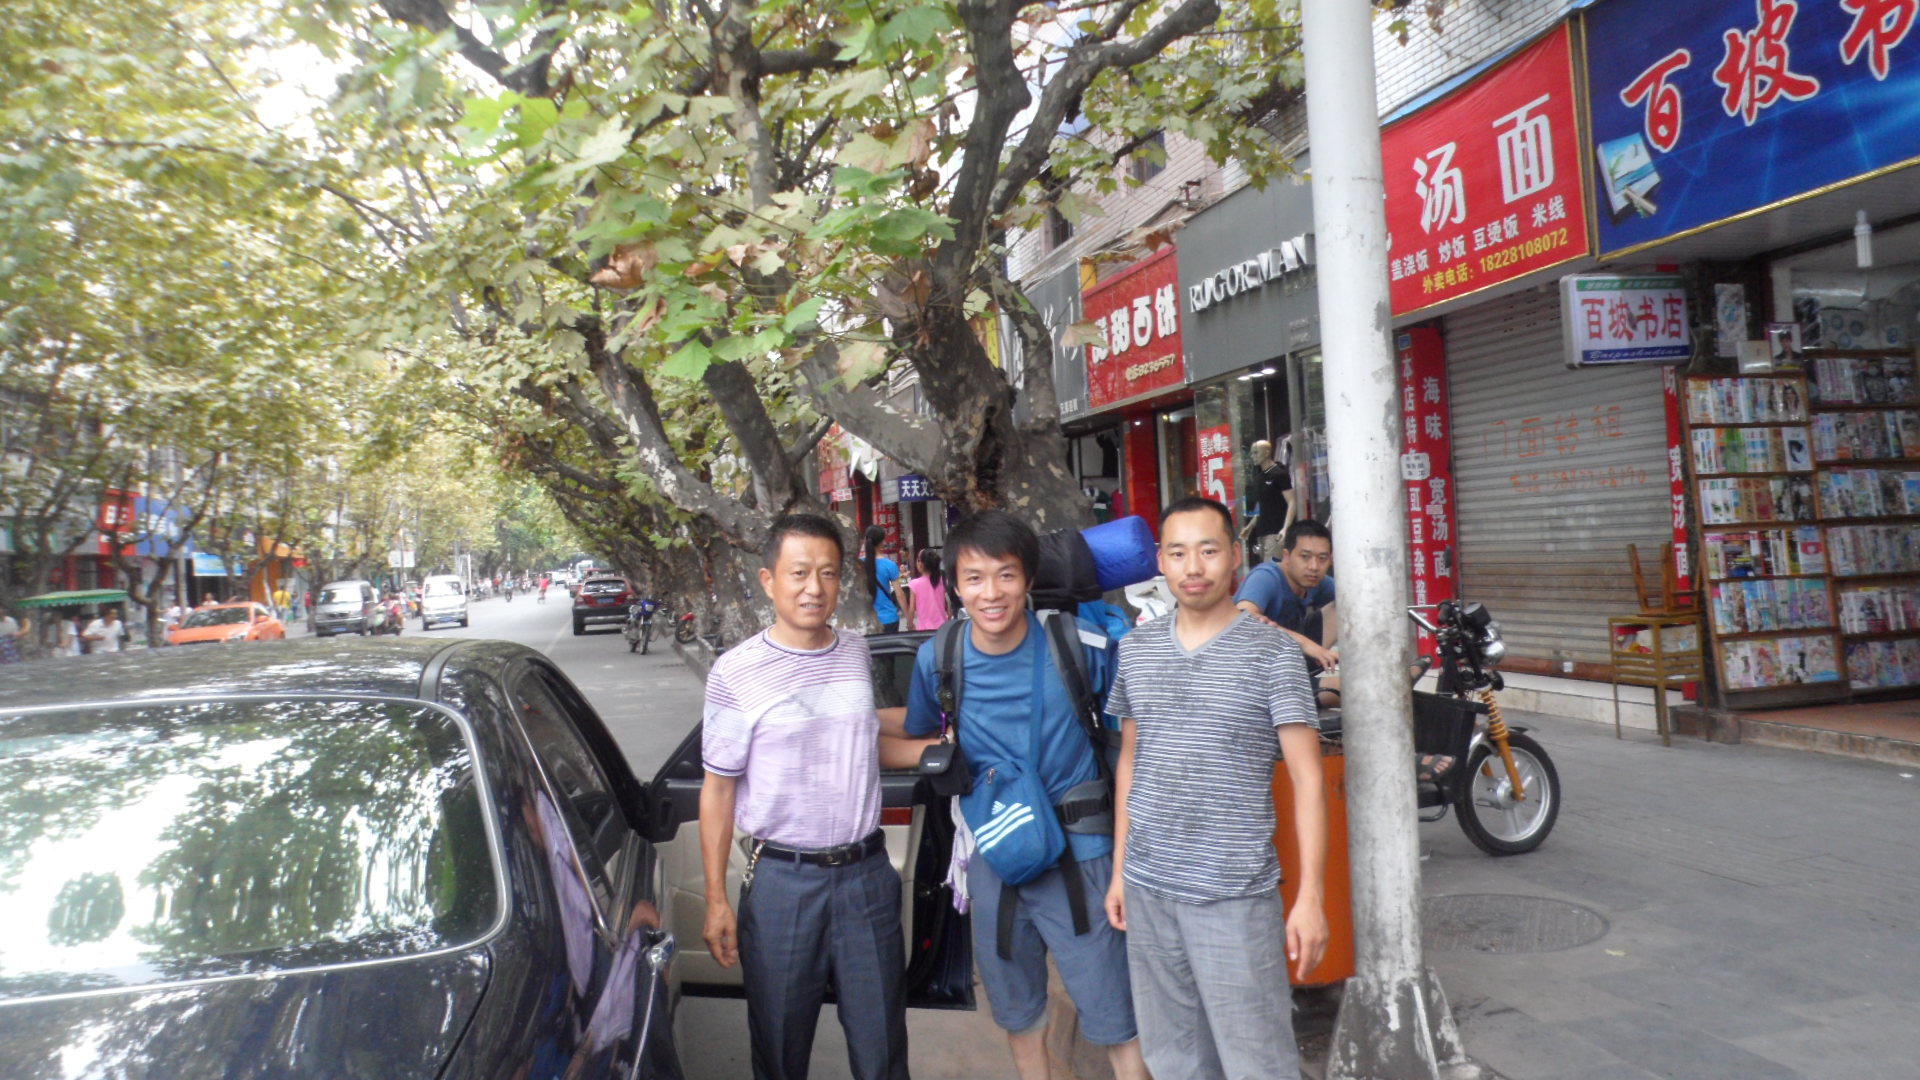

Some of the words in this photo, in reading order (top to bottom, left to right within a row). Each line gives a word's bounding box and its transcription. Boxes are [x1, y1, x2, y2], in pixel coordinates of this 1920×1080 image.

[1383, 93, 1555, 251] 汤面
[1189, 233, 1316, 313] ROGORMAN
[1391, 248, 1429, 281] 盖浇饭
[1437, 234, 1467, 264] 炒饭
[1531, 194, 1566, 228] 米线
[1479, 227, 1568, 274] 18228108072
[1581, 292, 1683, 341] 百坡书店
[1423, 376, 1443, 440] 海味
[901, 479, 935, 498] 天天文
[1429, 477, 1450, 579] 宽汤面
